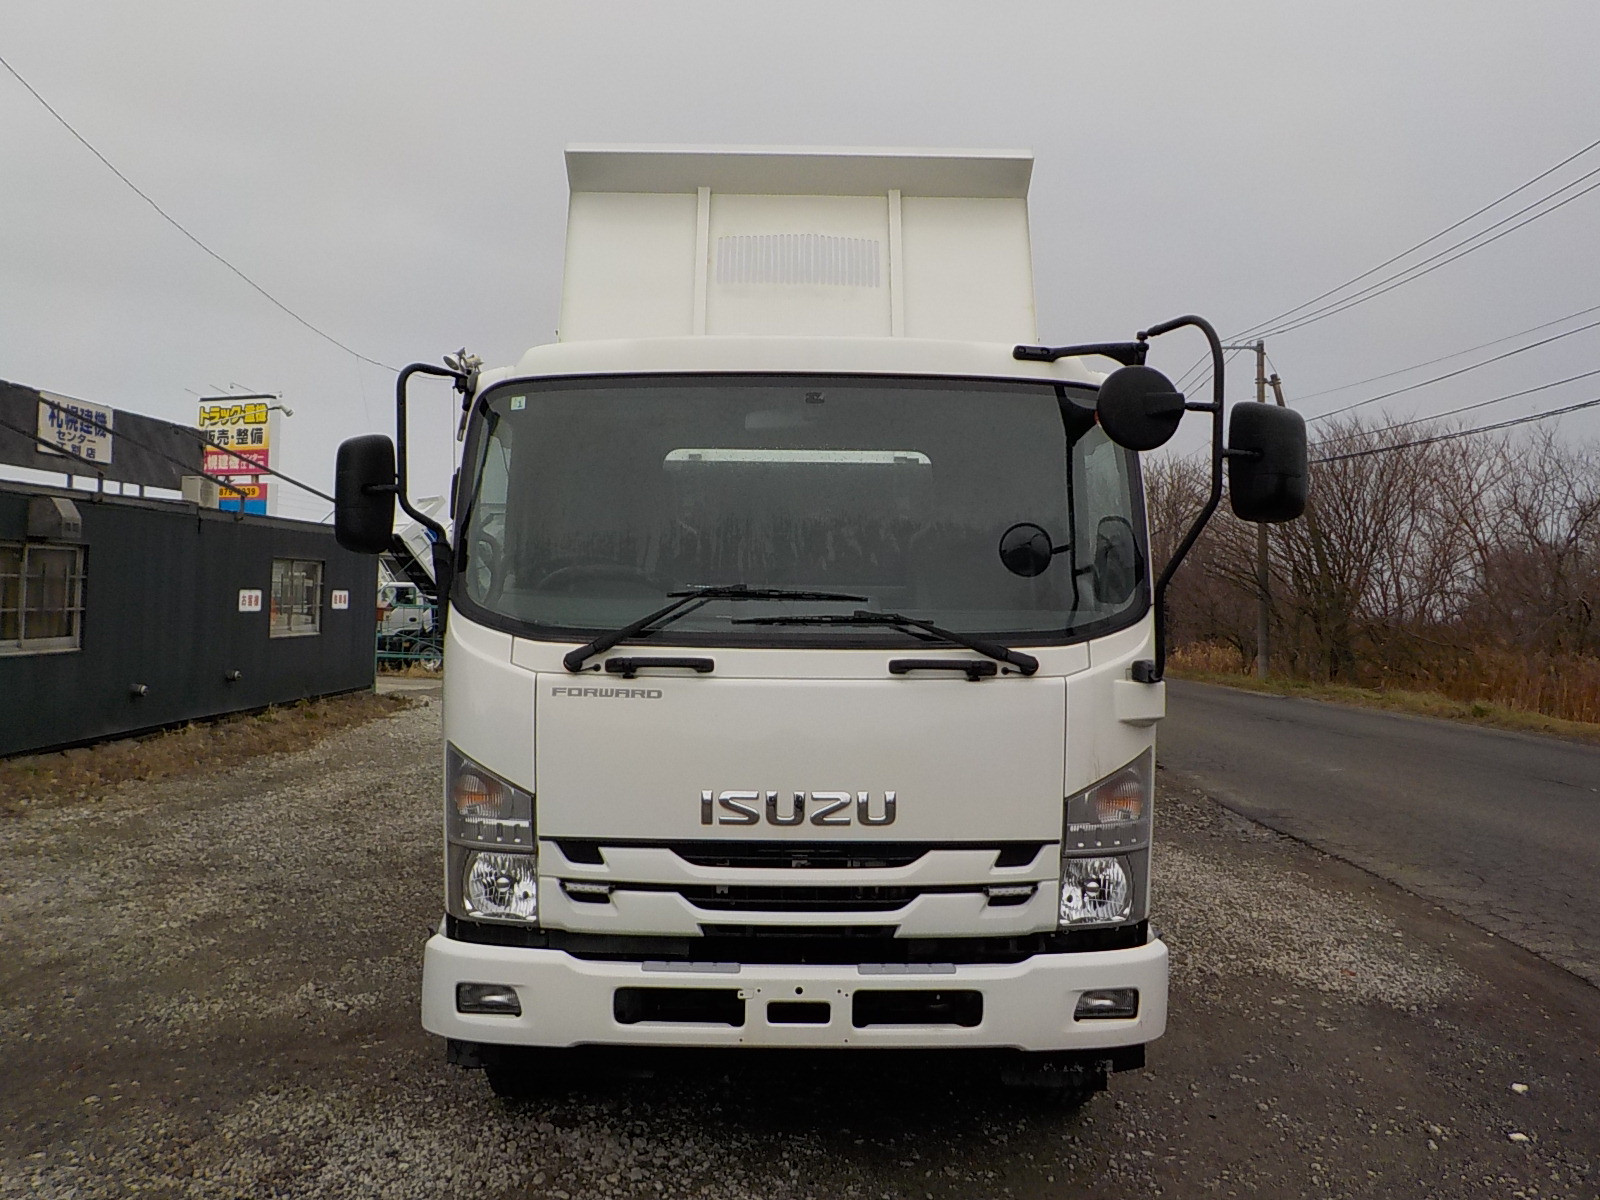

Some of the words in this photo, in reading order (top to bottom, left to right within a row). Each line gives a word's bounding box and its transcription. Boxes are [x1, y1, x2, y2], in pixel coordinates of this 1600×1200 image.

[56, 430, 96, 444] センター
[551, 687, 663, 699] FORWARD
[701, 789, 897, 826] ISUZU
